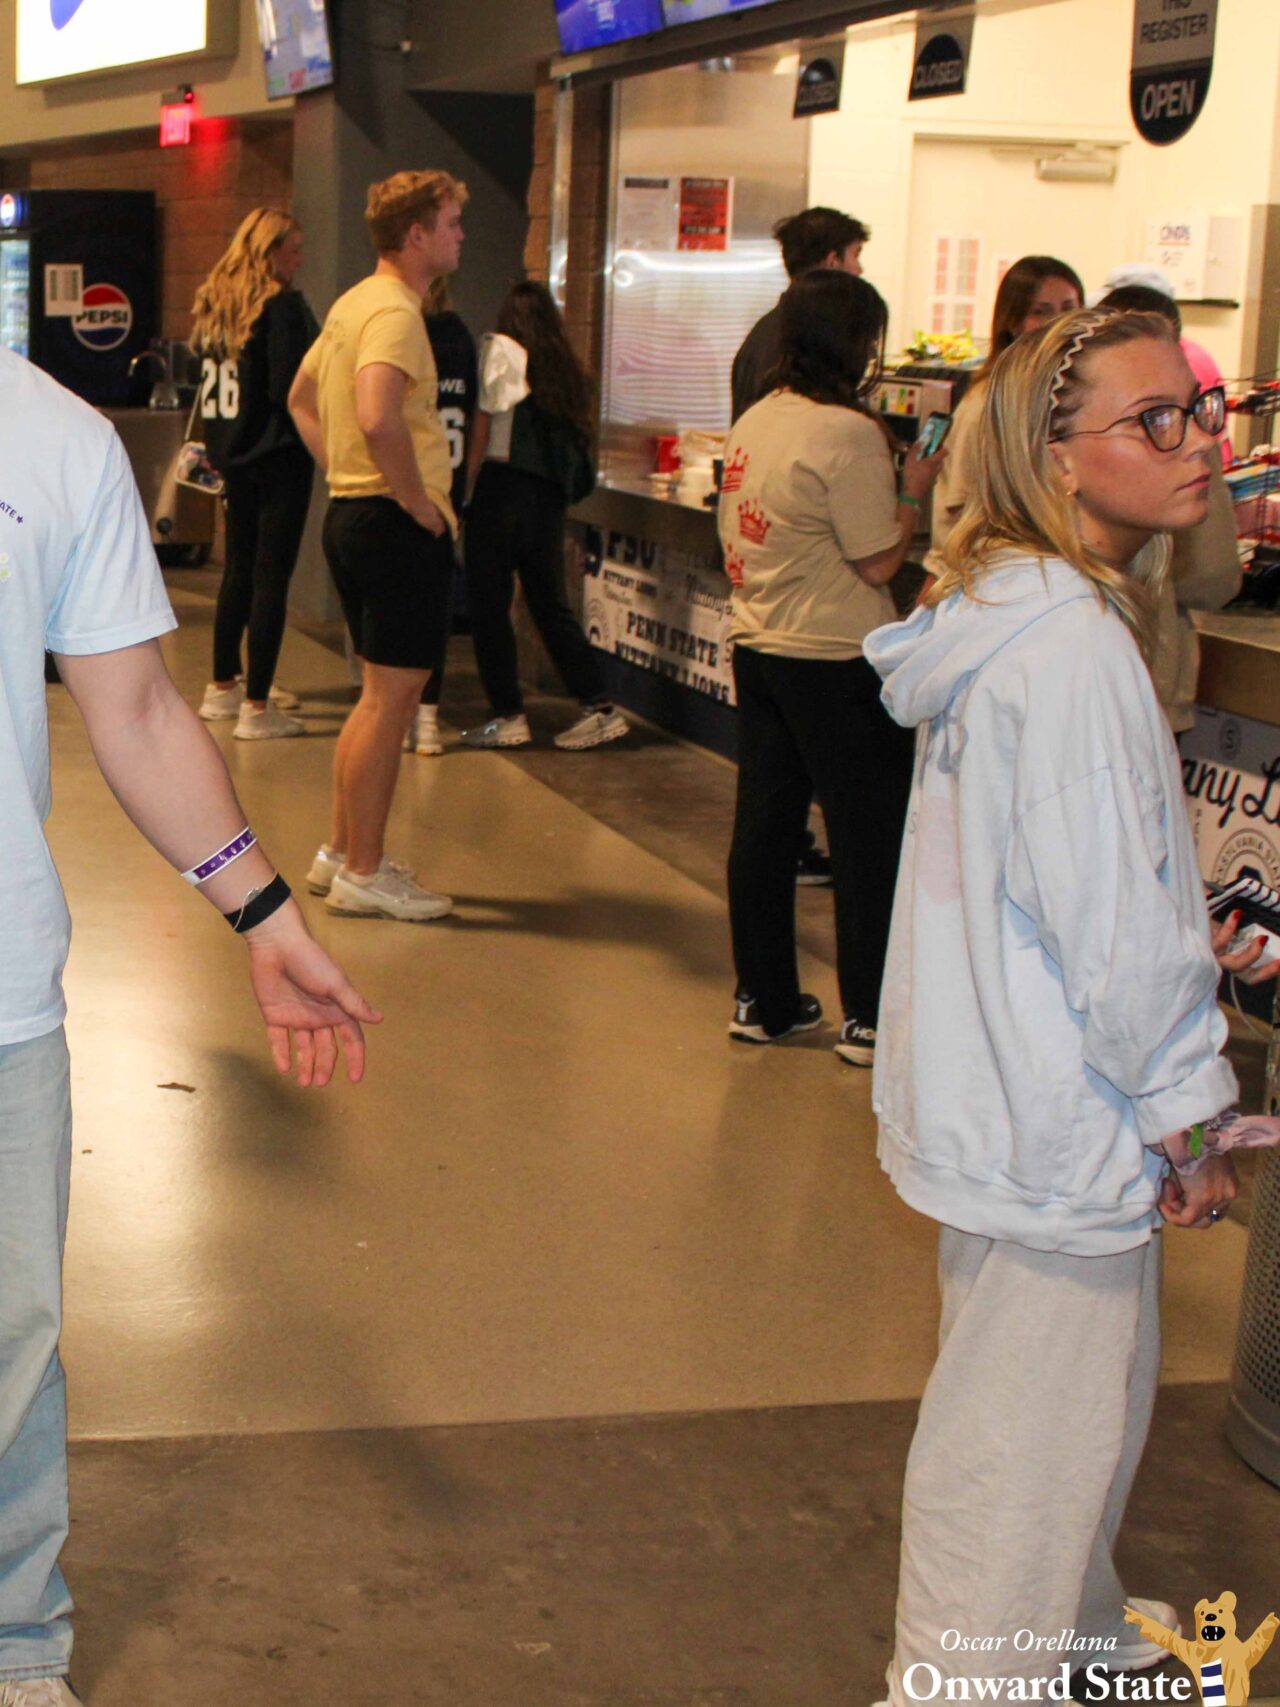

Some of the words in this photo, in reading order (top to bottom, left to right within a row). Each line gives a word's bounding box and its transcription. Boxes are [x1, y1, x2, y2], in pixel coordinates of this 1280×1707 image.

[1140, 14, 1209, 43] REGISTER
[914, 61, 962, 89] CLOSED
[1141, 79, 1197, 121] OPEN
[75, 309, 129, 323] PEPSI
[201, 358, 240, 420] 26
[627, 611, 668, 649] PENN
[669, 627, 719, 669] STATE
